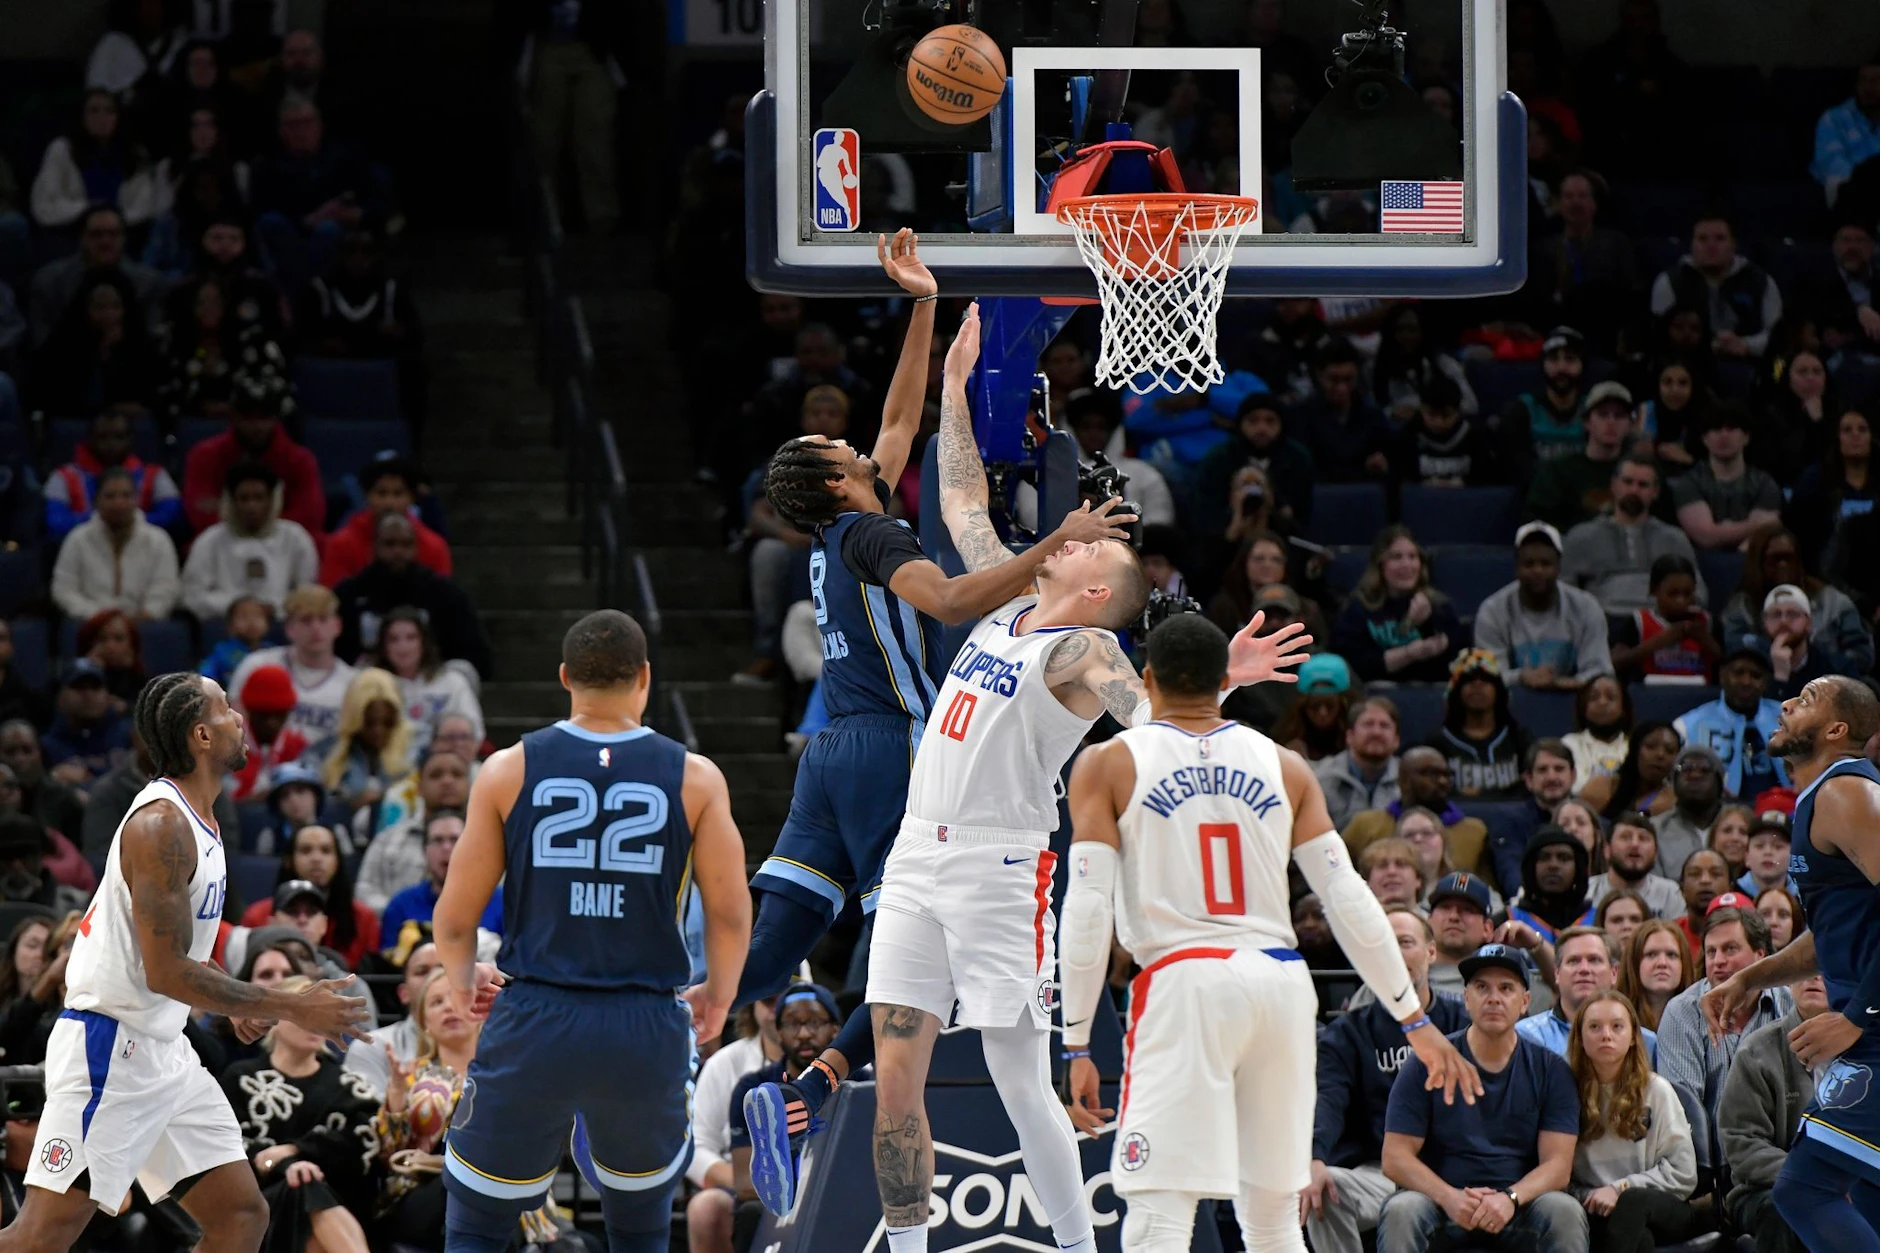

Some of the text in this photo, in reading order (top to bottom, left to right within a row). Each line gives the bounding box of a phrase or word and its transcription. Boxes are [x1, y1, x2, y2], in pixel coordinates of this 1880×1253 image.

[916, 69, 976, 108] Wilson
[821, 208, 843, 225] NBA
[809, 550, 828, 626] 8
[940, 689, 978, 742] 10
[1142, 766, 1282, 820] WESTBROOK
[532, 777, 669, 875] 22
[1199, 823, 1246, 916] 0
[569, 881, 625, 918] BANE
[926, 1171, 1120, 1228] SONC
